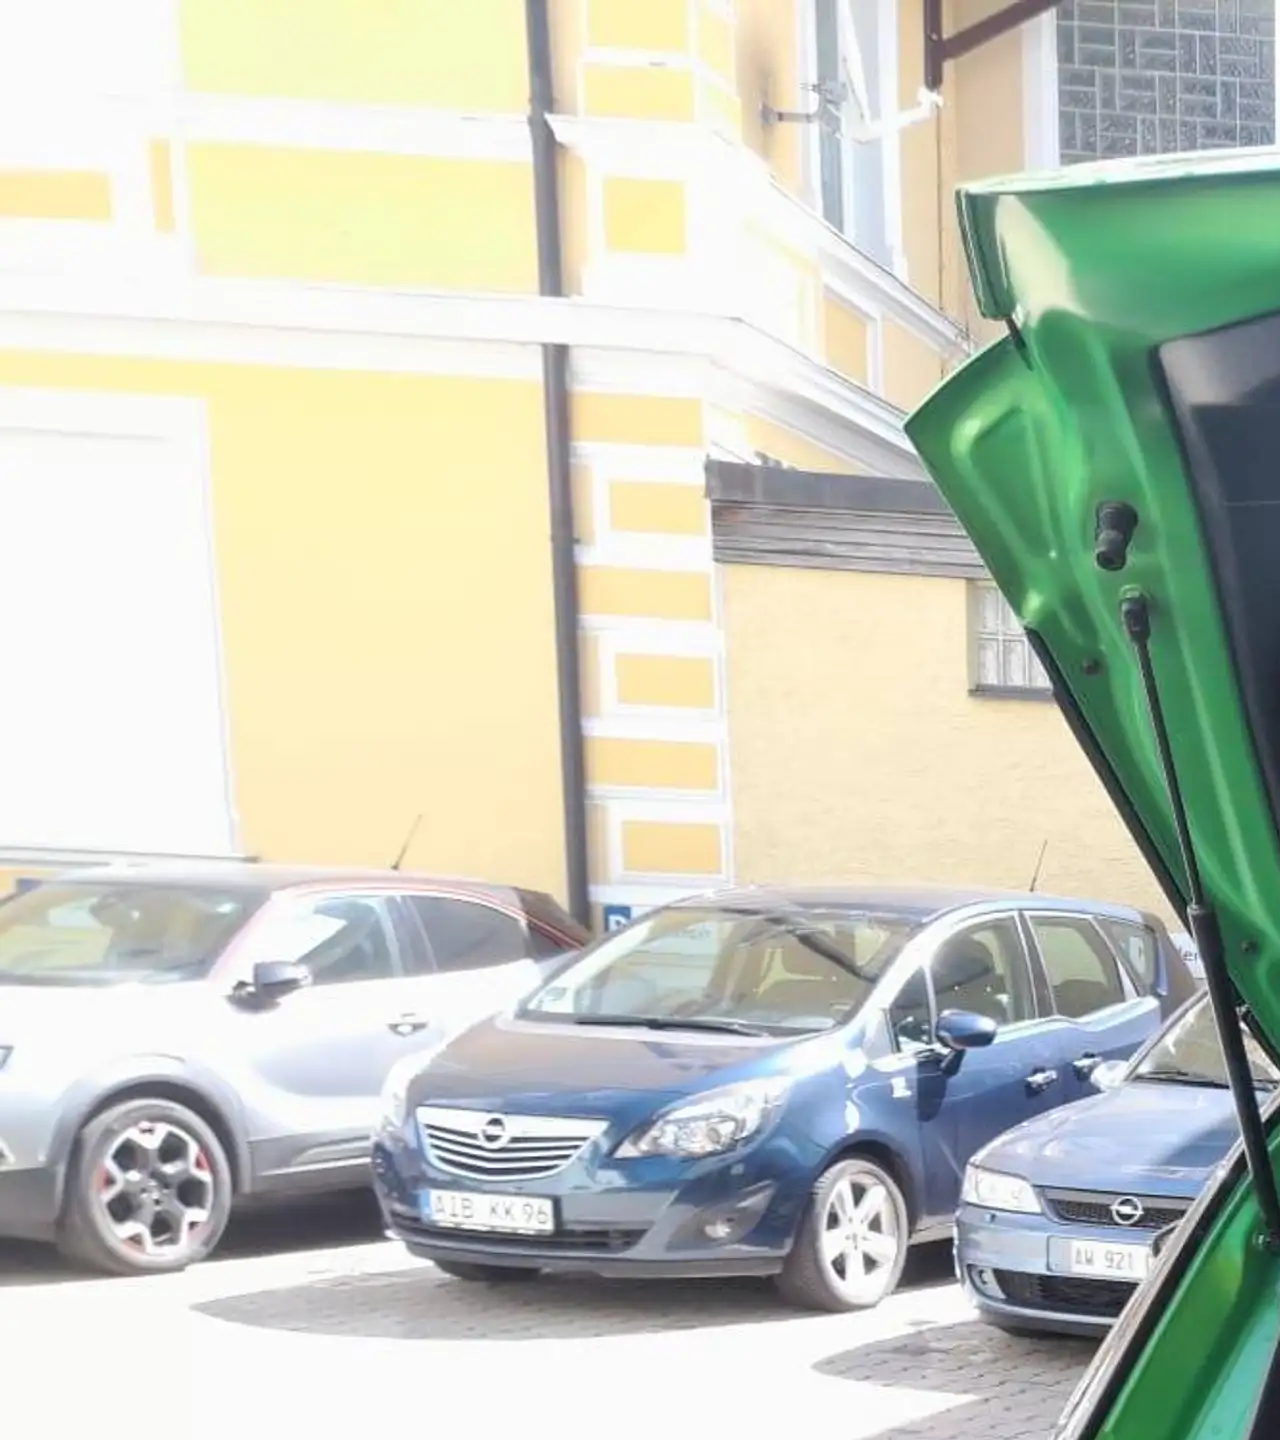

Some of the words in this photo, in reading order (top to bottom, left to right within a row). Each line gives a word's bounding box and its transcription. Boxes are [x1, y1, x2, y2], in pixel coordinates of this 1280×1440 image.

[435, 1195, 474, 1219] AIB
[490, 1200, 515, 1221] KK
[523, 1203, 549, 1225] 96
